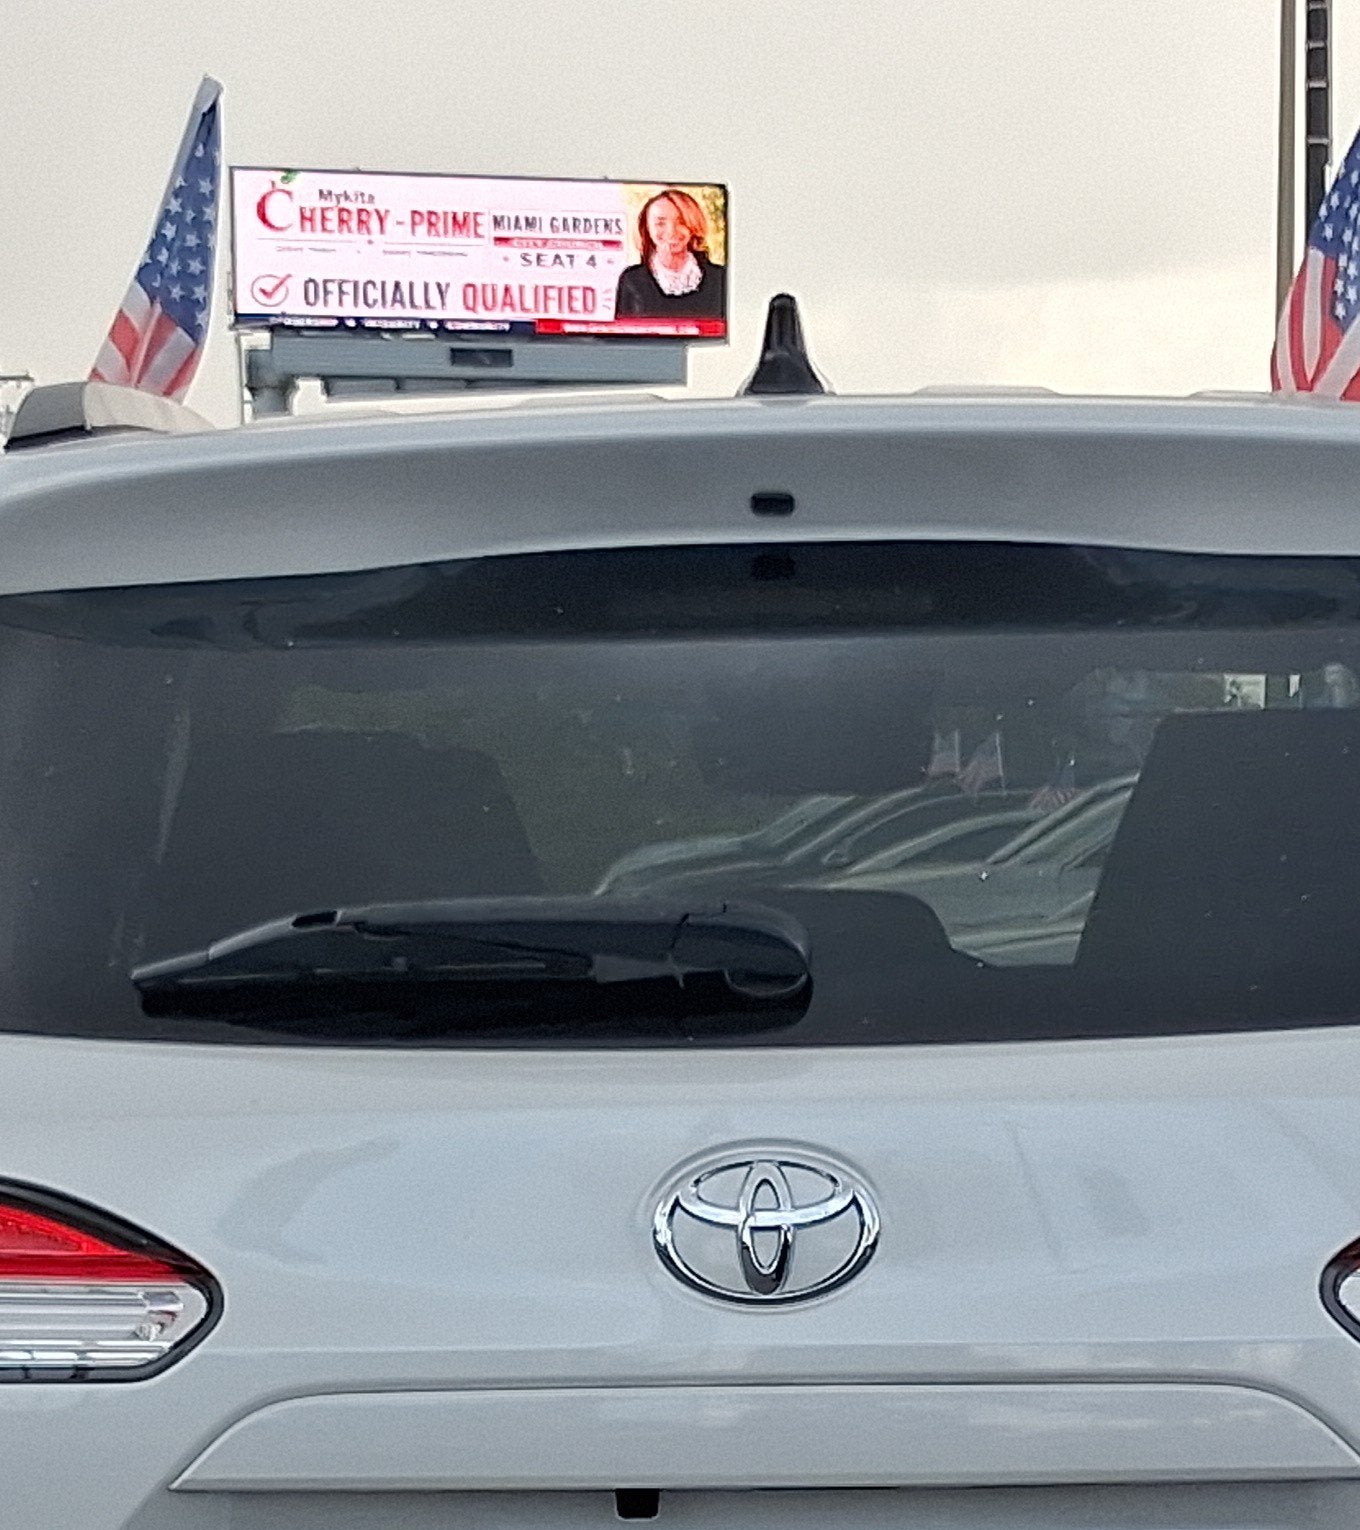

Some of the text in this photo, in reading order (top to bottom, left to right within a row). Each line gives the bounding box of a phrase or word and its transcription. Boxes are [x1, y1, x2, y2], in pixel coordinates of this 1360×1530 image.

[492, 214, 625, 236] MIAMI GARDENS
[520, 252, 598, 269] SEAT 4
[303, 277, 598, 315] OFFICIALLY QUALIFIED
